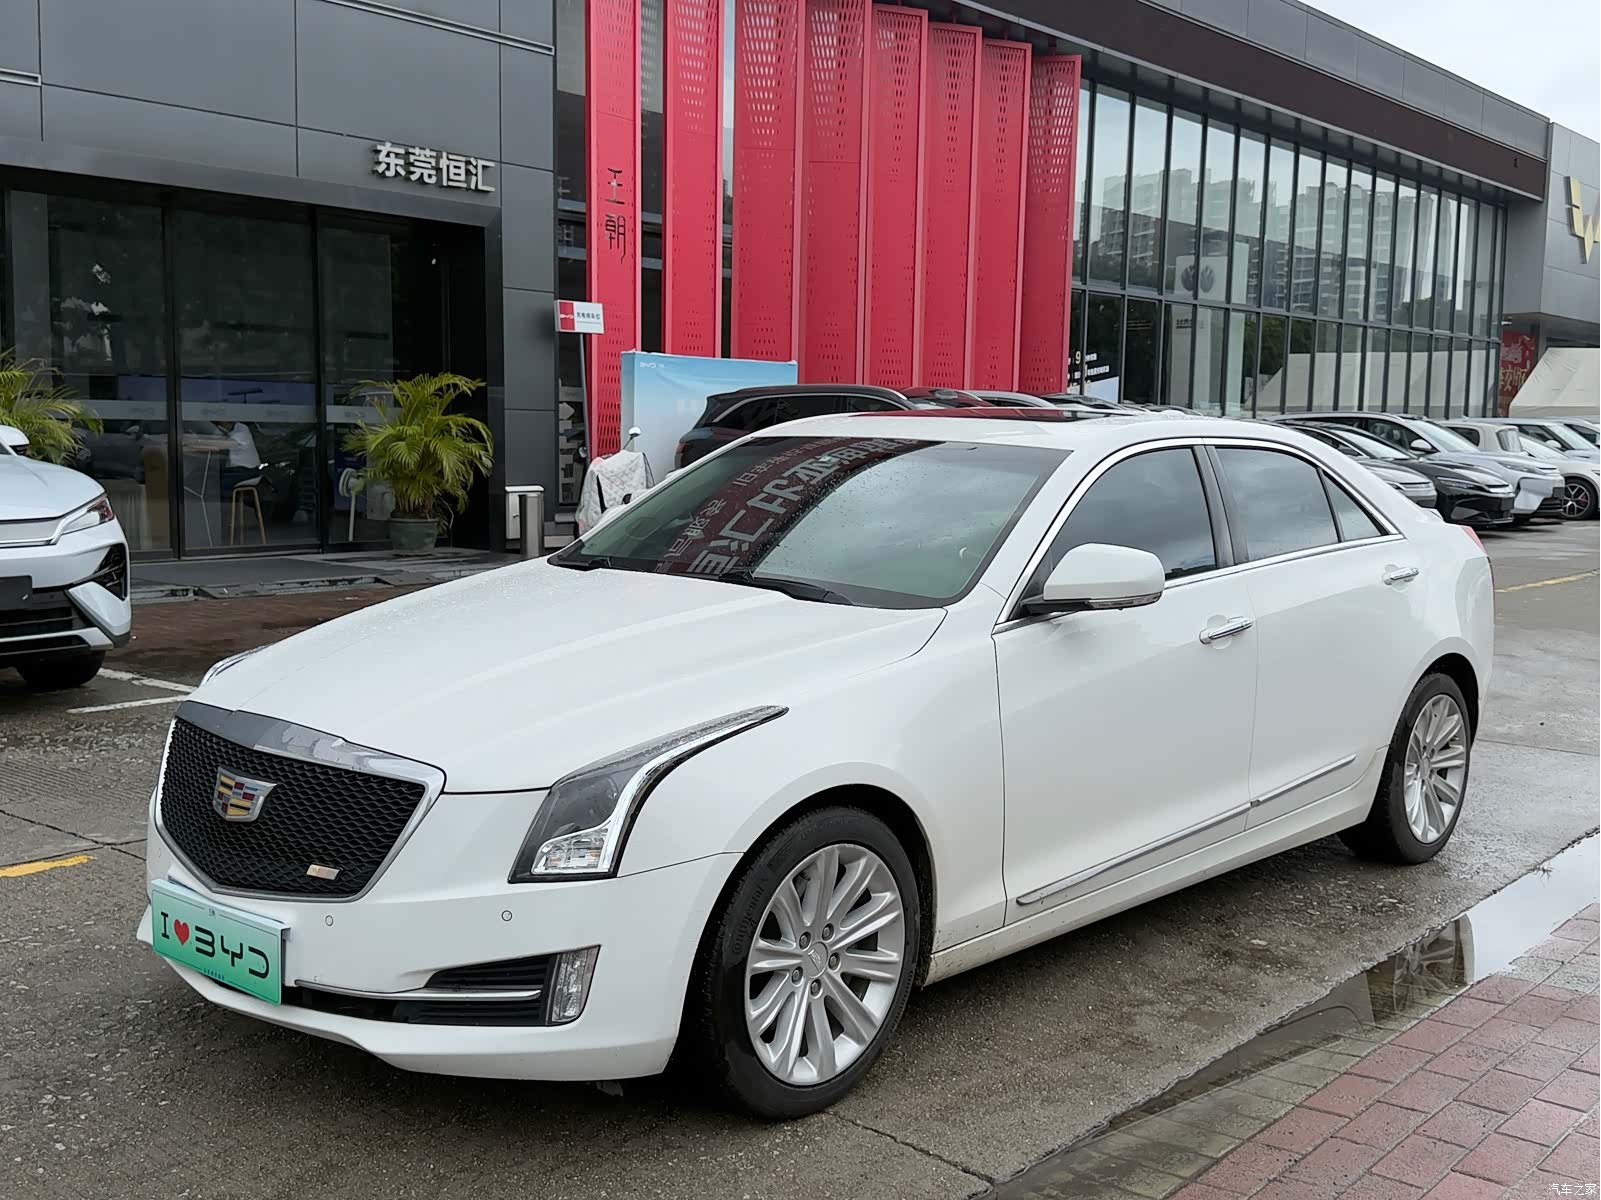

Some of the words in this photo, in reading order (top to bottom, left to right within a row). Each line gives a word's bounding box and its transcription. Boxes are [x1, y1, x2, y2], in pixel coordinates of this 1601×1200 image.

[376, 142, 496, 192] 东莞恒汇
[194, 925, 270, 979] BYD
